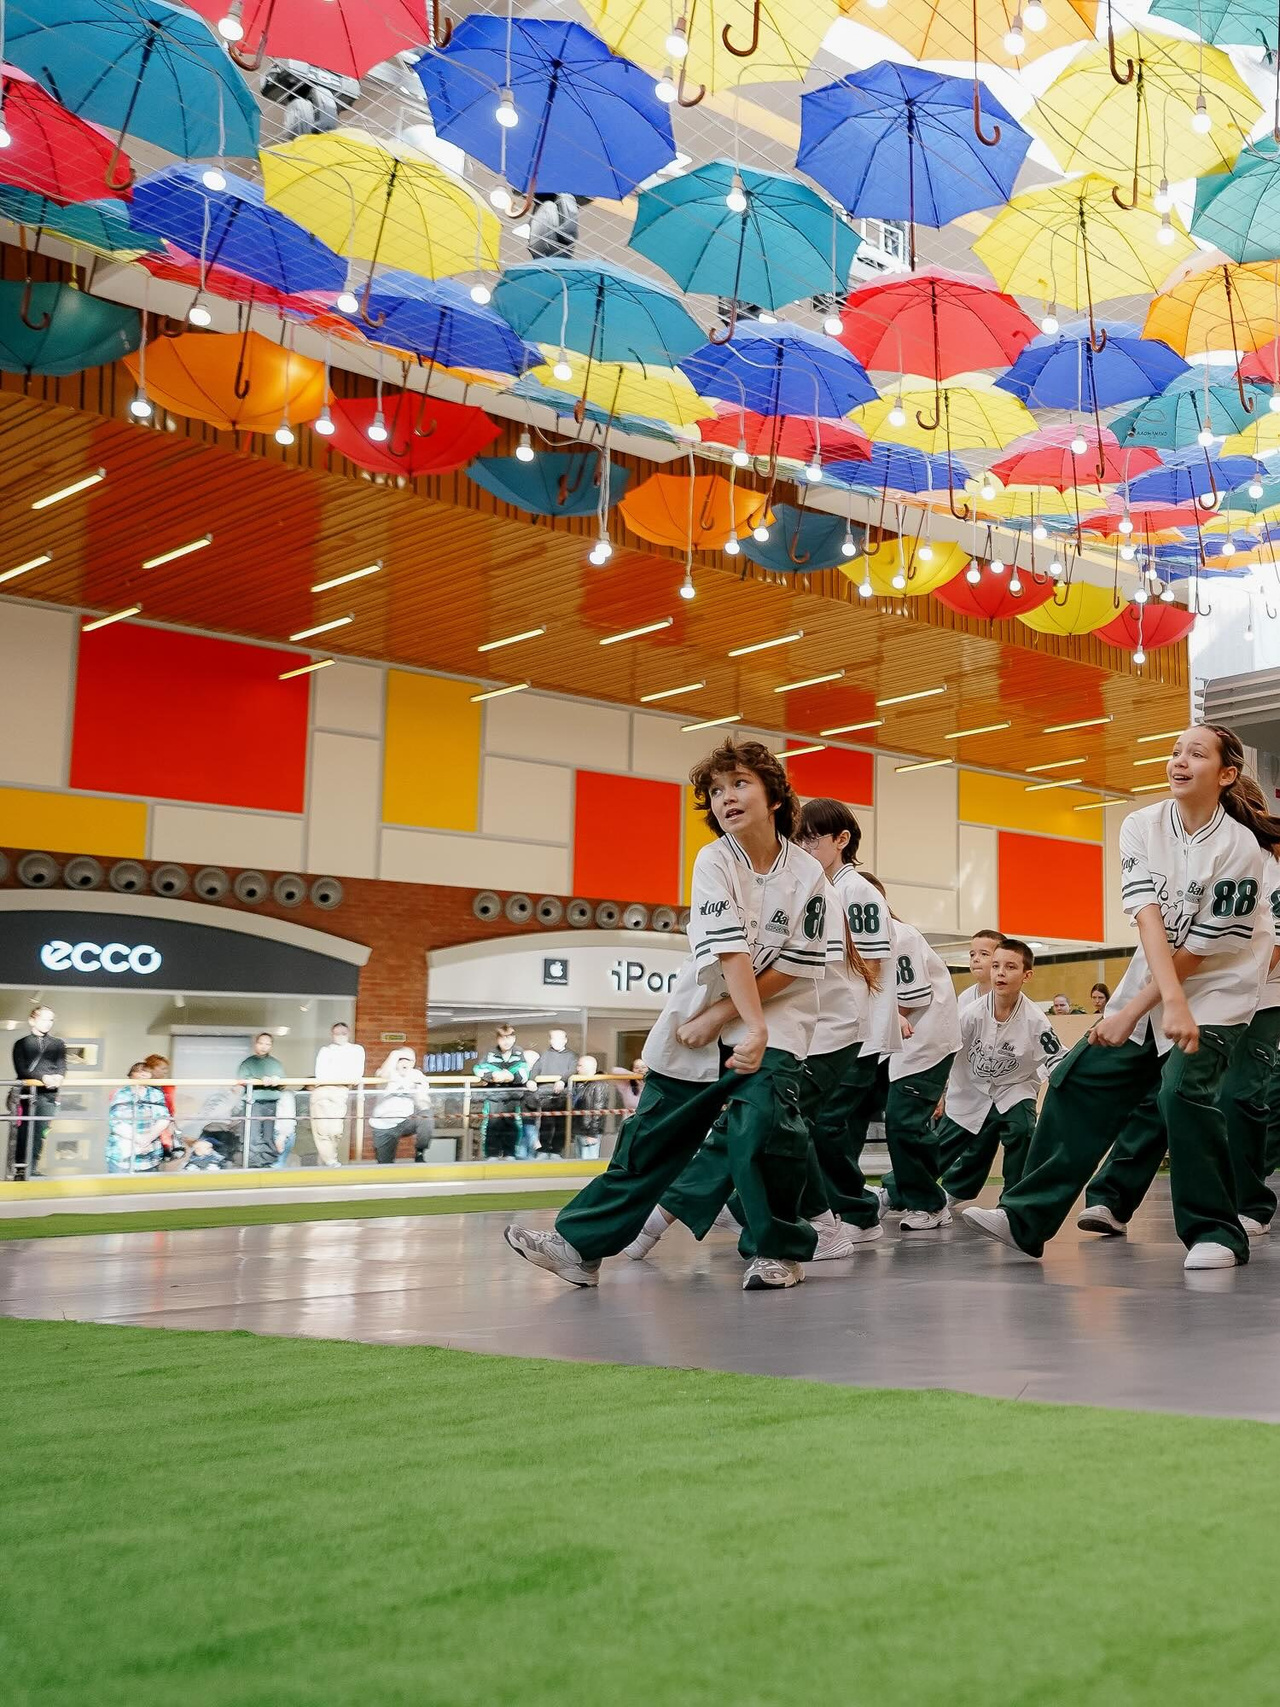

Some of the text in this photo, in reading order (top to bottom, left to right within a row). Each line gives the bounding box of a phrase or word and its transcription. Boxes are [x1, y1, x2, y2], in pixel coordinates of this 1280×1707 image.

[1211, 877, 1261, 919] 88
[848, 902, 881, 934] 88
[41, 940, 162, 975] ecco
[611, 960, 677, 993] iPor
